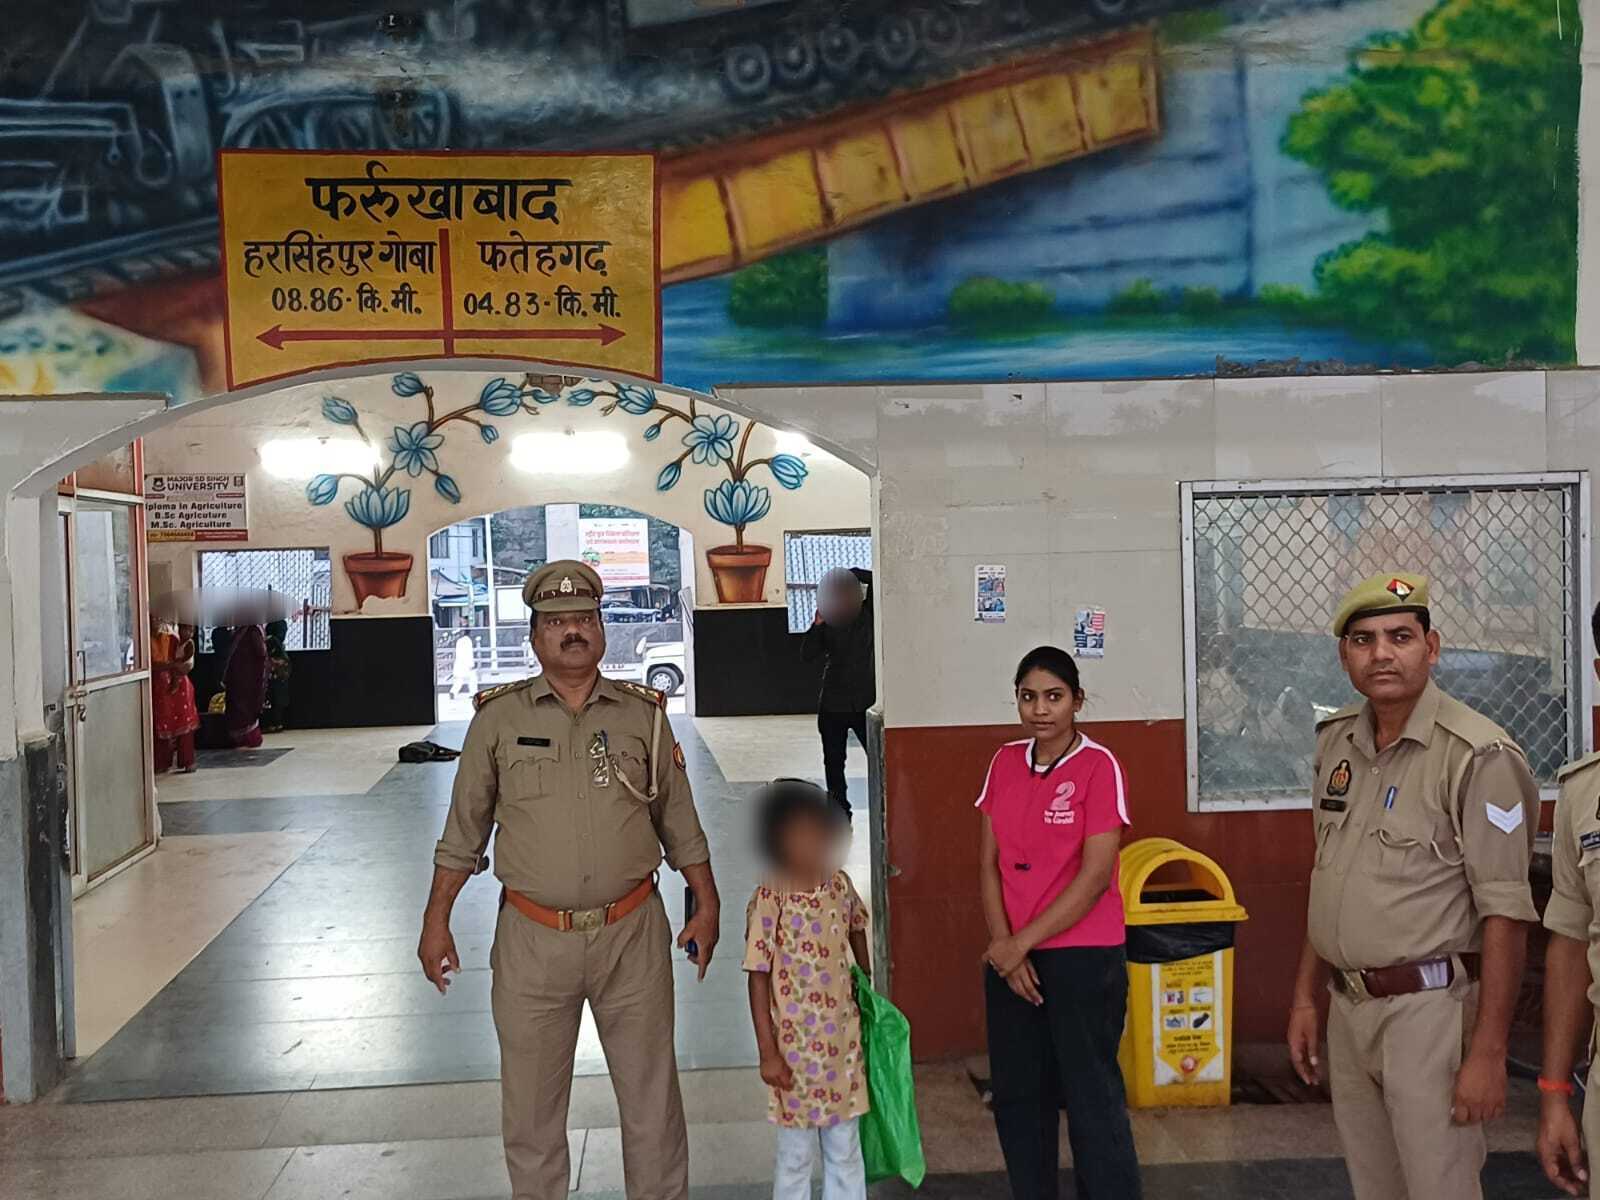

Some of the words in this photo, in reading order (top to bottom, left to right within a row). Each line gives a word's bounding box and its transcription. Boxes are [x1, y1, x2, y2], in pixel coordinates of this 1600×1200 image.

[377, 231, 437, 274] गोबा
[167, 482, 228, 490] UNIVERSITY
[145, 502, 177, 511] iploma
[180, 502, 188, 510] in
[191, 502, 242, 511] Agriculture
[155, 511, 175, 519] B.Sc
[151, 521, 177, 529] M.Sc.
[180, 521, 232, 530] Agriculture
